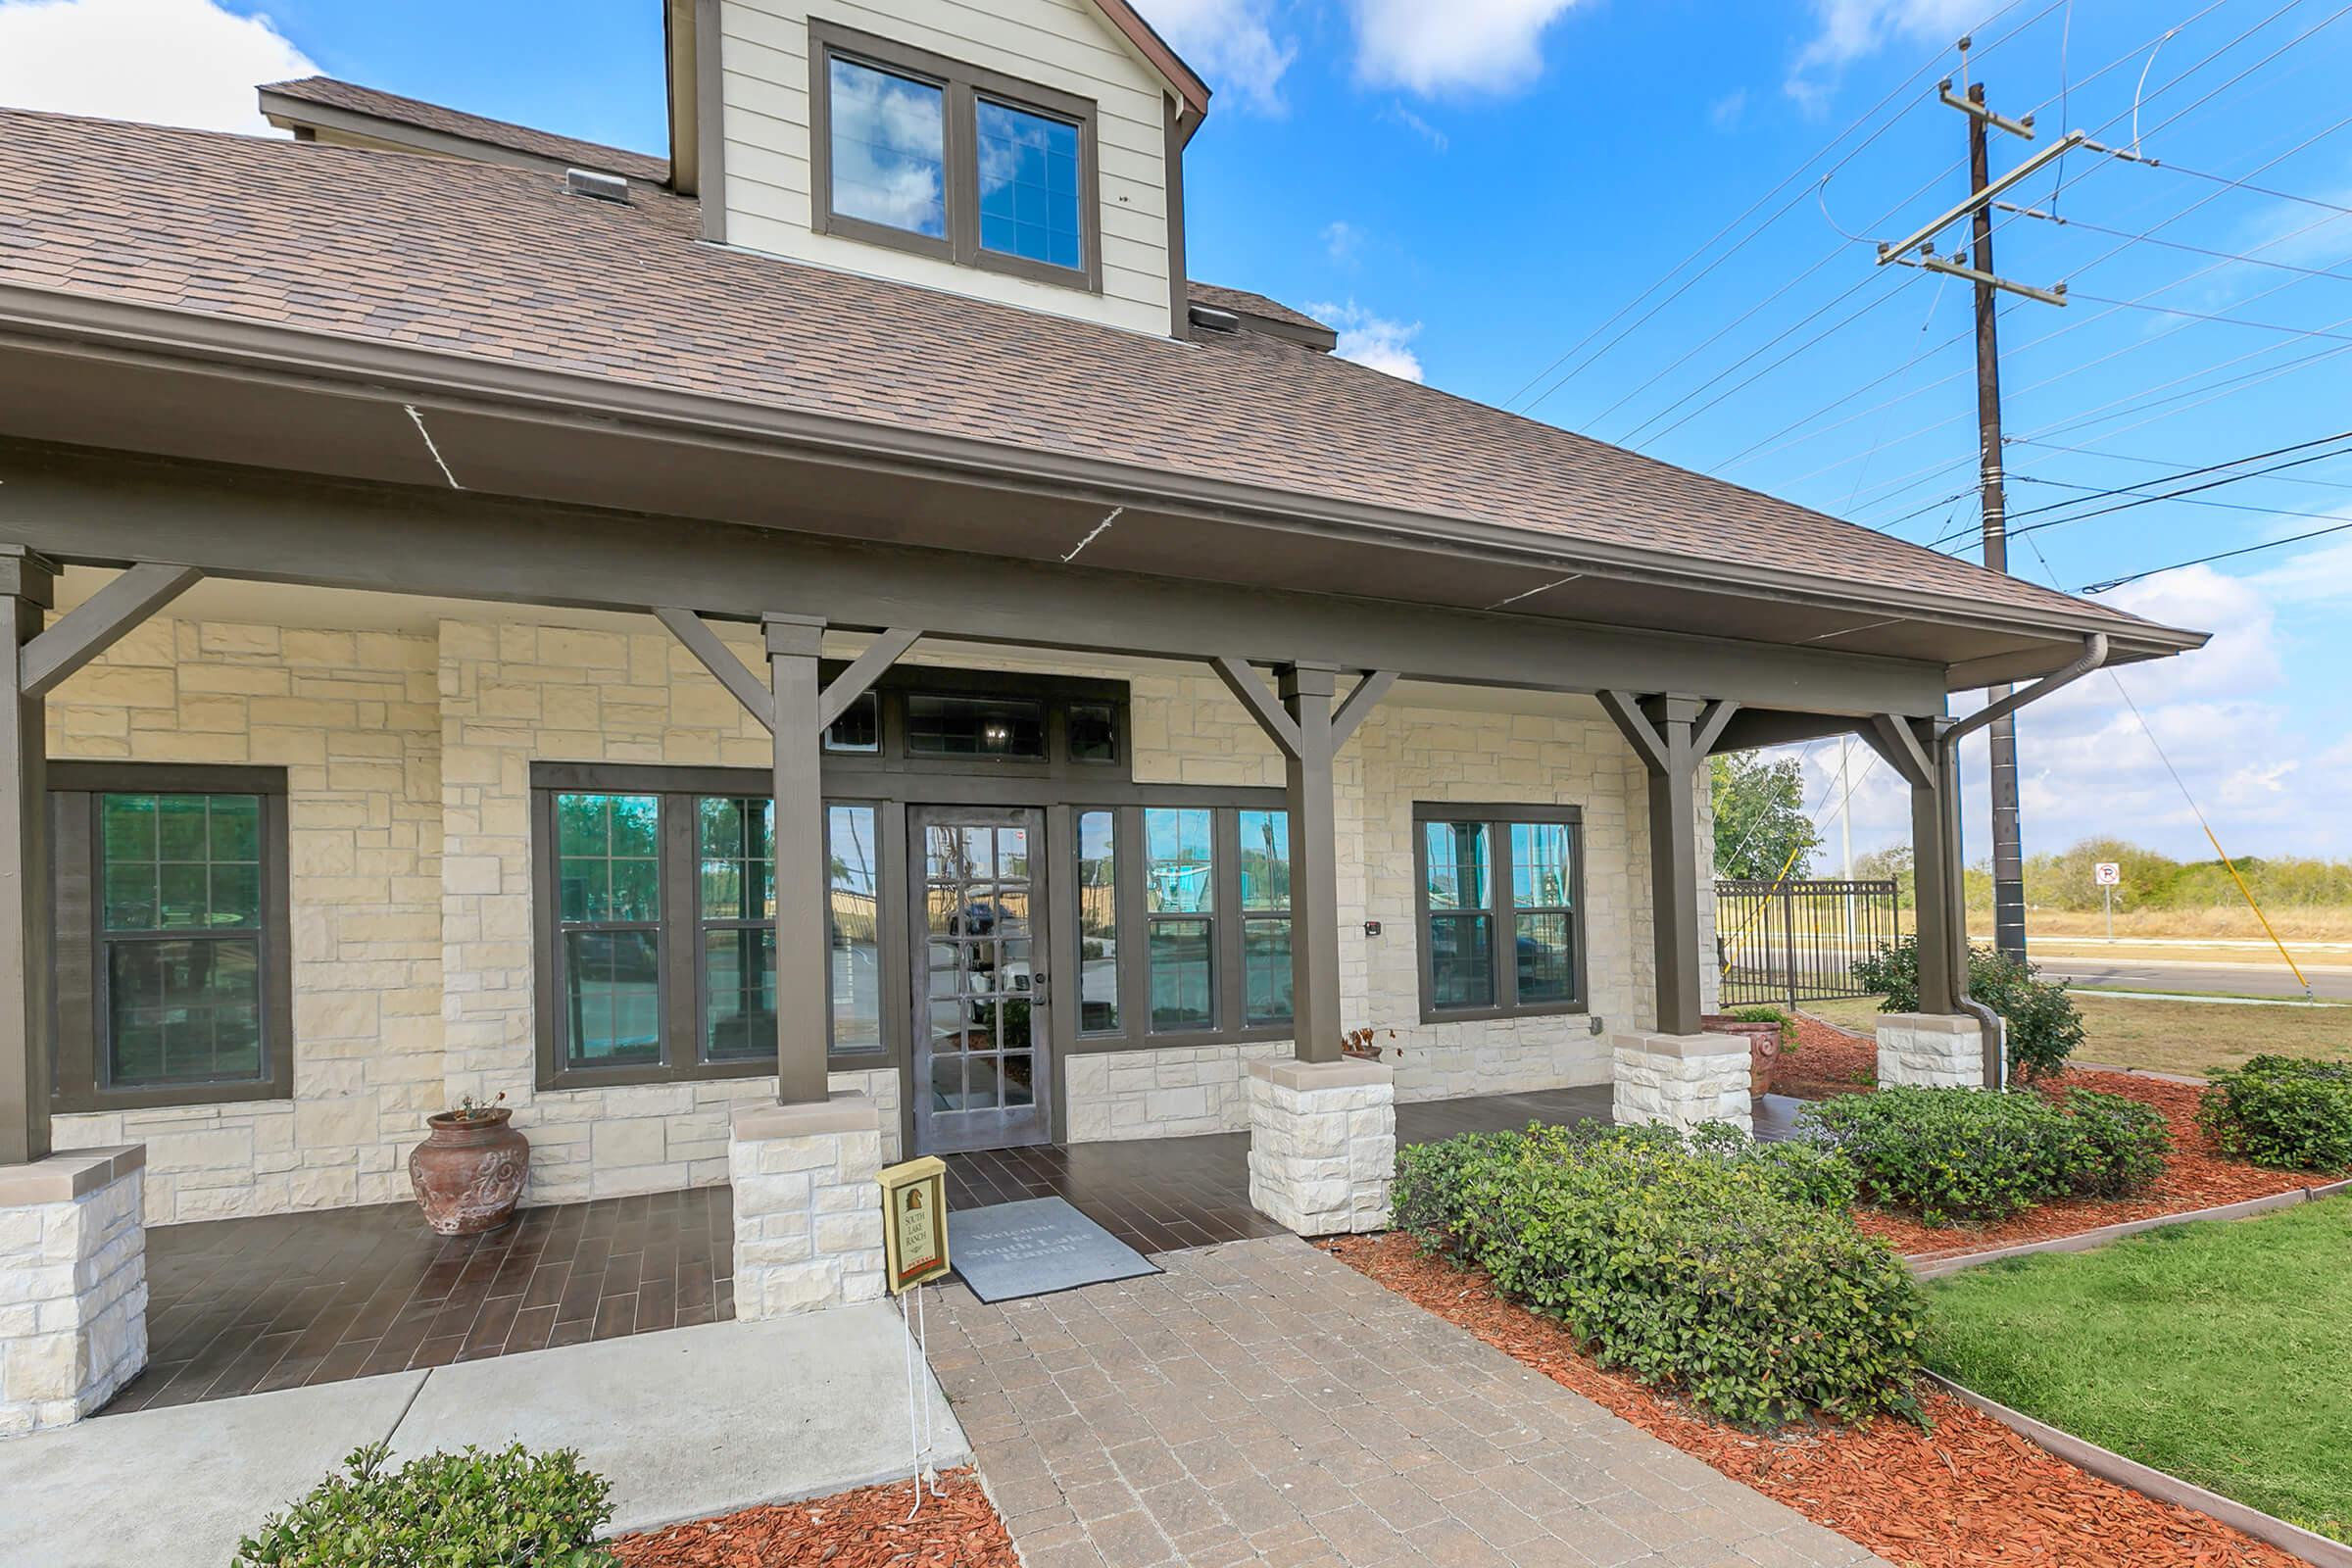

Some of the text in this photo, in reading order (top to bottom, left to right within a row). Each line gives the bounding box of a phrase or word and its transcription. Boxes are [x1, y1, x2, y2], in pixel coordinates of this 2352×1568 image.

[905, 1212, 925, 1225] SOUTH
[907, 1224, 922, 1235] LAKE
[971, 1224, 1054, 1240] Welcome
[906, 1231, 927, 1247] RANCH
[964, 1234, 1094, 1256] South Lake
[1003, 1245, 1077, 1260] Ranch
